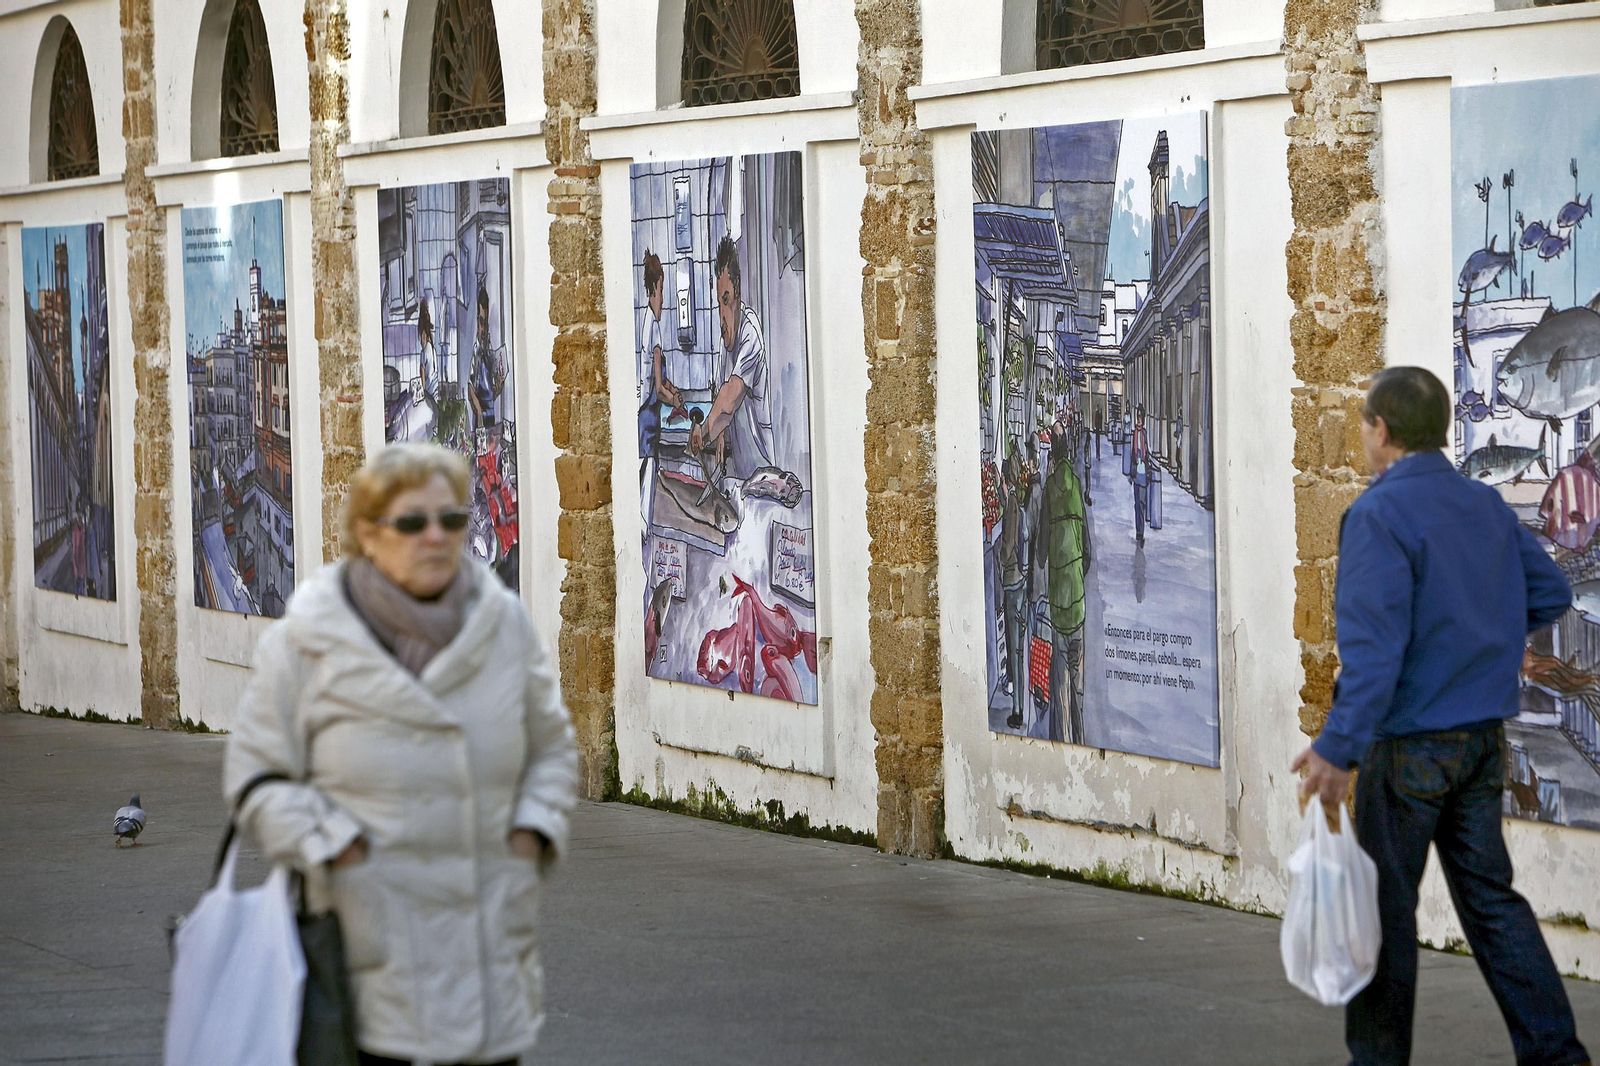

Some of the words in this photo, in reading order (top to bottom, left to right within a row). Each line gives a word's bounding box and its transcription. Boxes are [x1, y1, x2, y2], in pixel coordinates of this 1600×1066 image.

[1105, 623, 1132, 640] «Entonces
[1133, 629, 1146, 643] para
[1146, 628, 1152, 641] el
[1153, 632, 1169, 647] pargo
[1170, 634, 1192, 649] compro
[1105, 645, 1115, 658] dos
[1116, 646, 1138, 663] limones,
[1183, 657, 1201, 671] espera
[1106, 669, 1112, 679] un
[1142, 674, 1152, 687] por
[1153, 671, 1162, 685] ahí
[1162, 674, 1177, 687] viene
